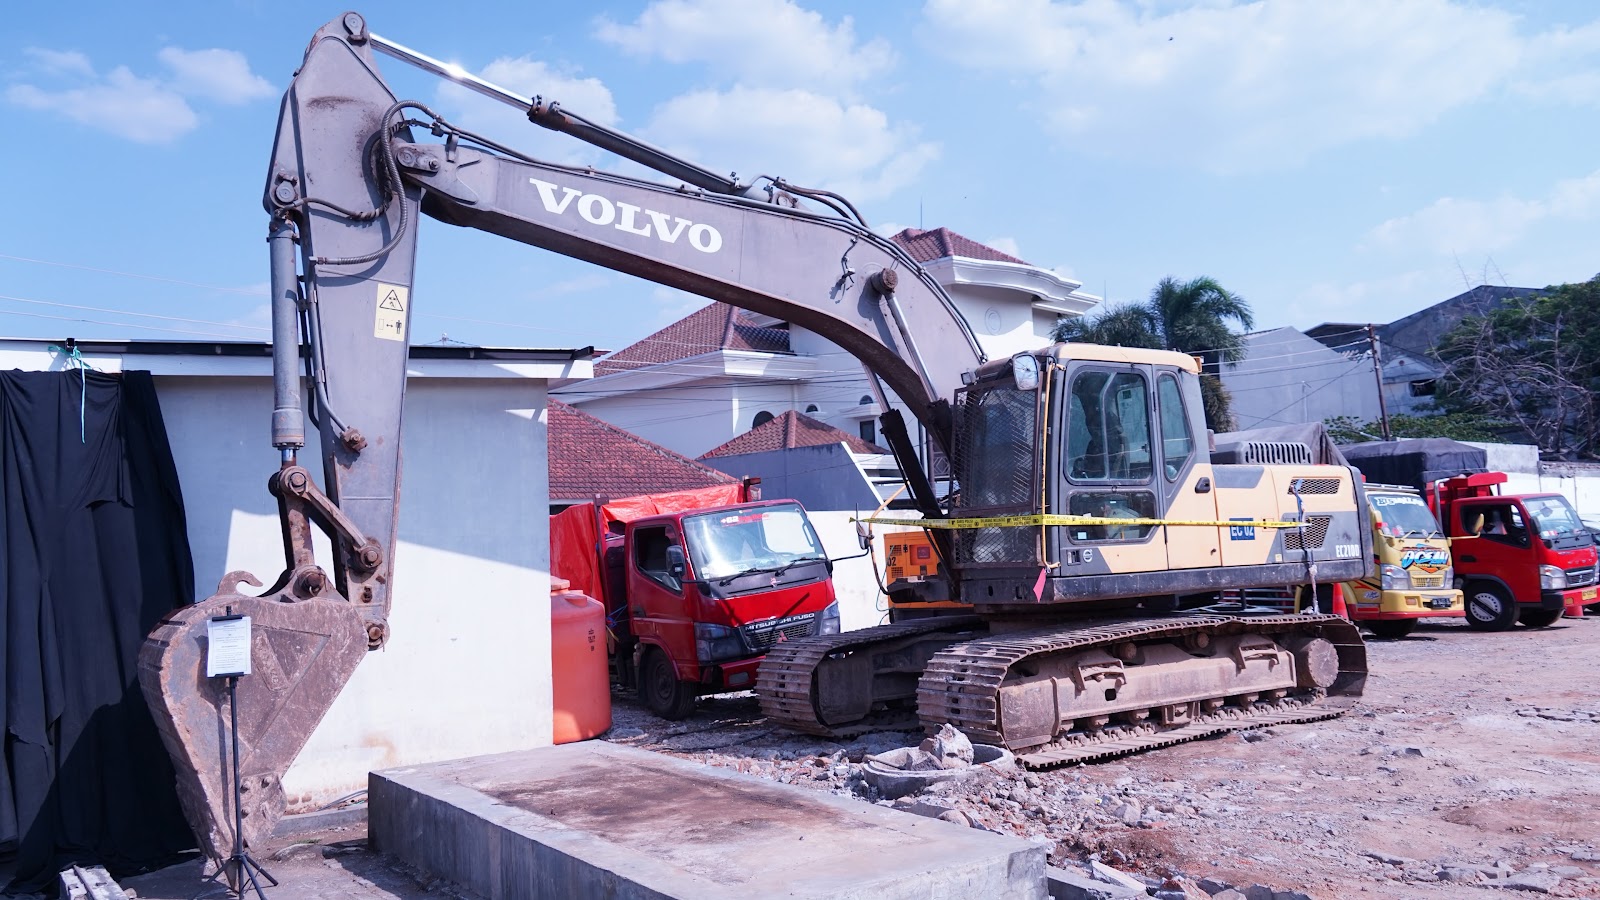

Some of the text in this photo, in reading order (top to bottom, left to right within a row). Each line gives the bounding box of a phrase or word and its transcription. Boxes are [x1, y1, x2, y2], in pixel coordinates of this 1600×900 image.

[529, 177, 723, 254] VOLVO
[1231, 525, 1243, 537] EC
[1335, 544, 1360, 558] EC210D
[793, 612, 815, 621] FUSO
